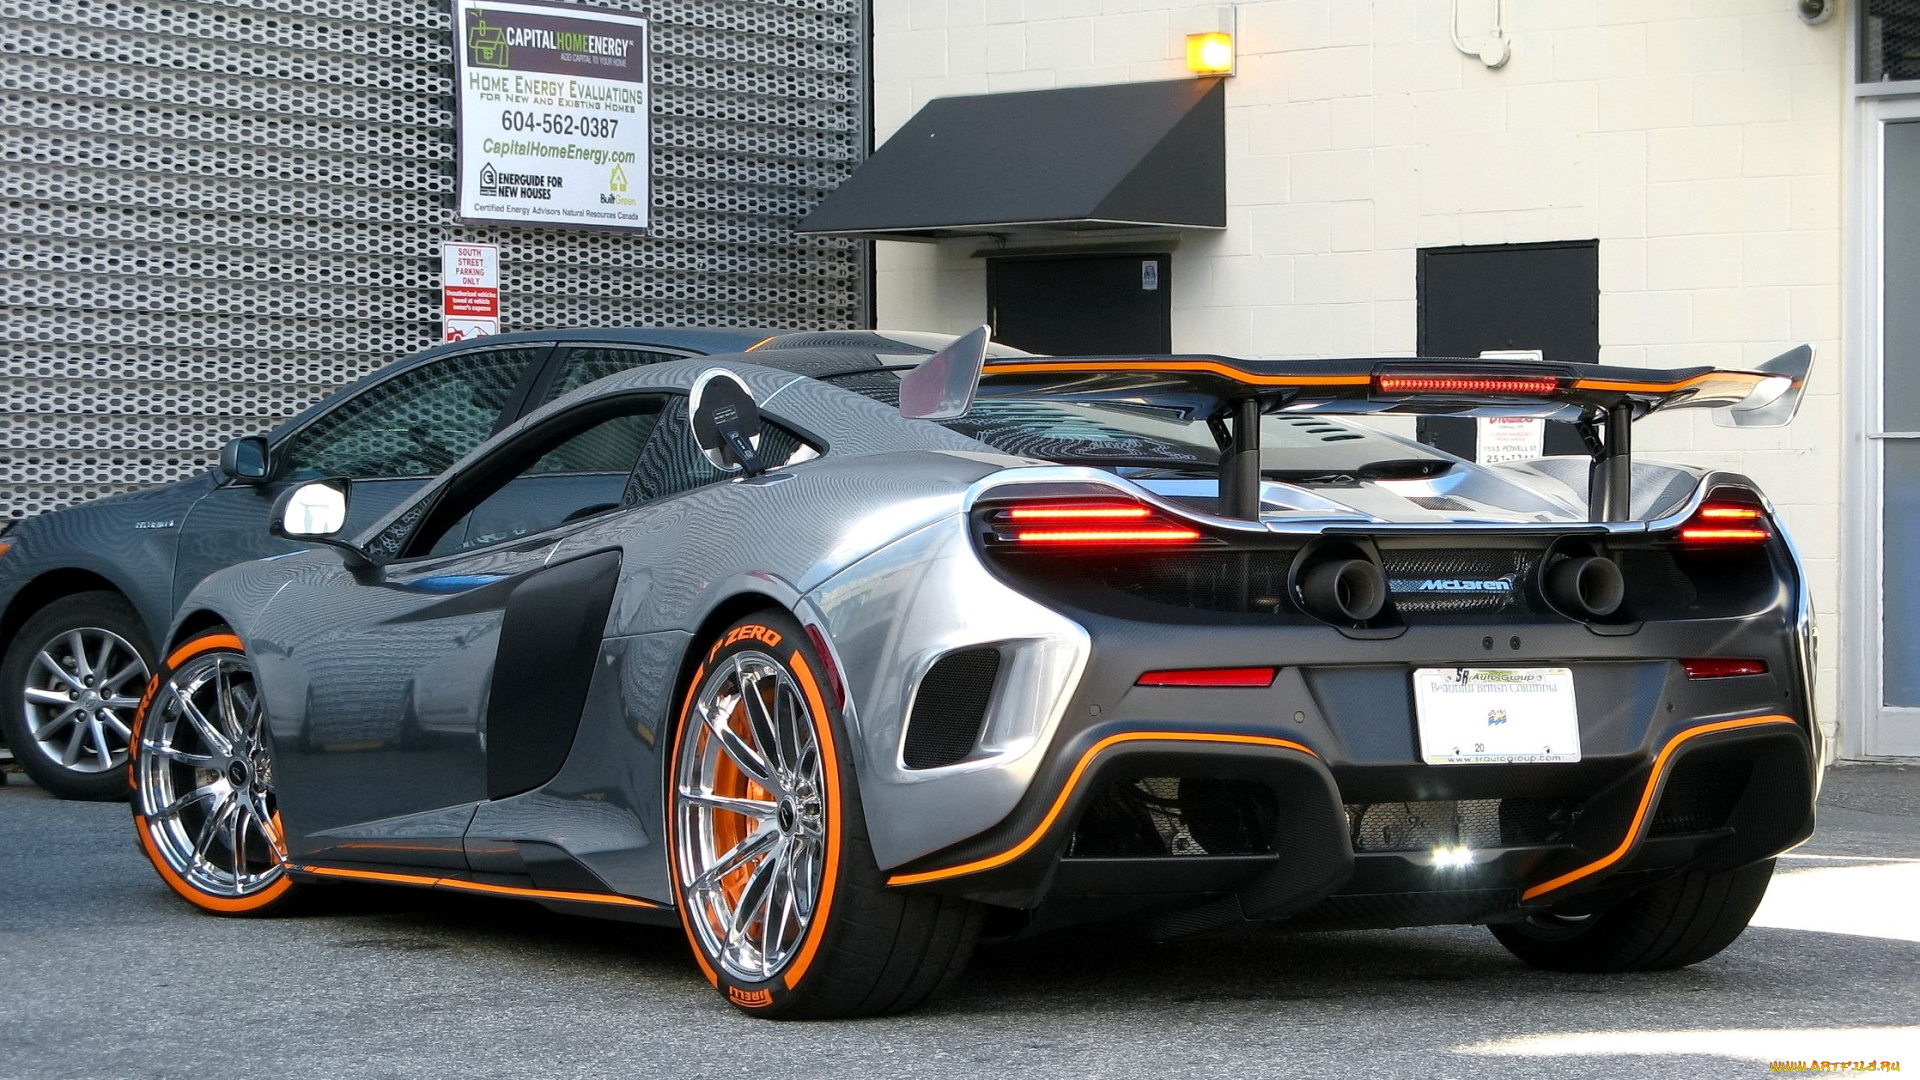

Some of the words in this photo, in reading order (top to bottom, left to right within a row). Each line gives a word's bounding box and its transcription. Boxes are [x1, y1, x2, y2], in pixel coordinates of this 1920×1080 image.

[560, 53, 572, 62] ADD
[573, 54, 592, 64] CAPITAL
[592, 56, 599, 65] TO
[600, 56, 612, 66] YOUR
[612, 58, 627, 68] HOME
[502, 110, 619, 138] 604-562-0387
[483, 138, 636, 165] CapitalHomeEnergy.com
[498, 172, 545, 187] ENERGUIDE
[547, 175, 563, 188] FOR
[498, 185, 518, 198] NEW
[520, 187, 551, 200] HOUSES
[474, 203, 505, 213] Certified
[506, 205, 530, 215] Energy
[531, 207, 561, 216] Advisors
[562, 208, 585, 217] Natural
[585, 209, 617, 219] Resources
[617, 212, 639, 220] Canada
[458, 248, 482, 257] SOUTH
[458, 258, 484, 267] STREET
[455, 267, 485, 277] PARKING
[462, 277, 480, 286] ONLY
[1419, 580, 1510, 590] McLaren
[709, 639, 724, 664] P
[725, 624, 782, 647] ZERO
[1456, 668, 1469, 685] SR
[1499, 674, 1535, 683] Group
[1431, 682, 1476, 693] Beautiful
[129, 673, 159, 760] ZERO
[1474, 743, 1485, 753] 20
[1447, 755, 1561, 764] www.srautogroup.com
[729, 985, 773, 1008] PIRELLI
